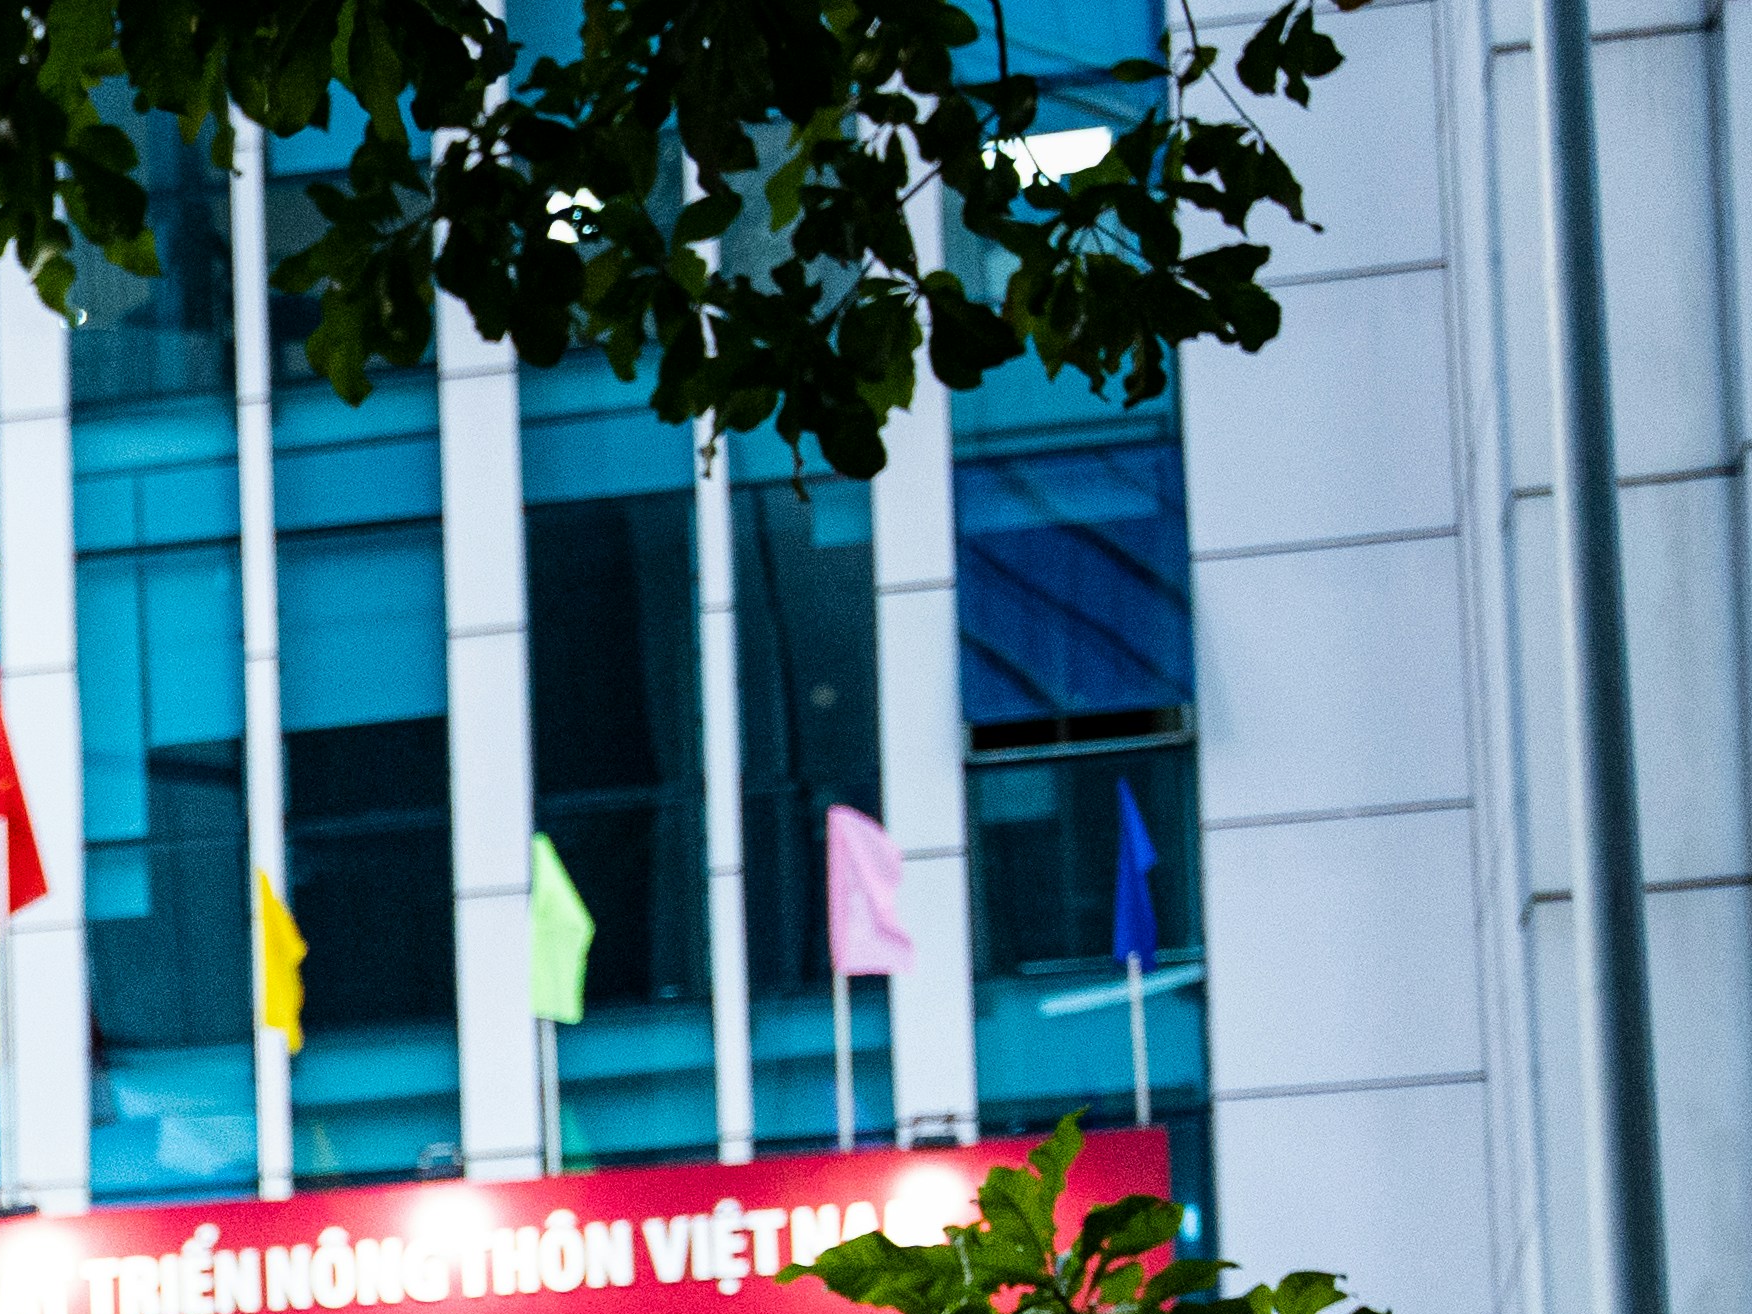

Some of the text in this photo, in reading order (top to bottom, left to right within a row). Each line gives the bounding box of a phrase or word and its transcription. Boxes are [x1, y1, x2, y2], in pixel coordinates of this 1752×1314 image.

[264, 1225, 451, 1312] NÔNG
[455, 1208, 635, 1298] THÔN
[642, 1197, 788, 1296] VIỆT
